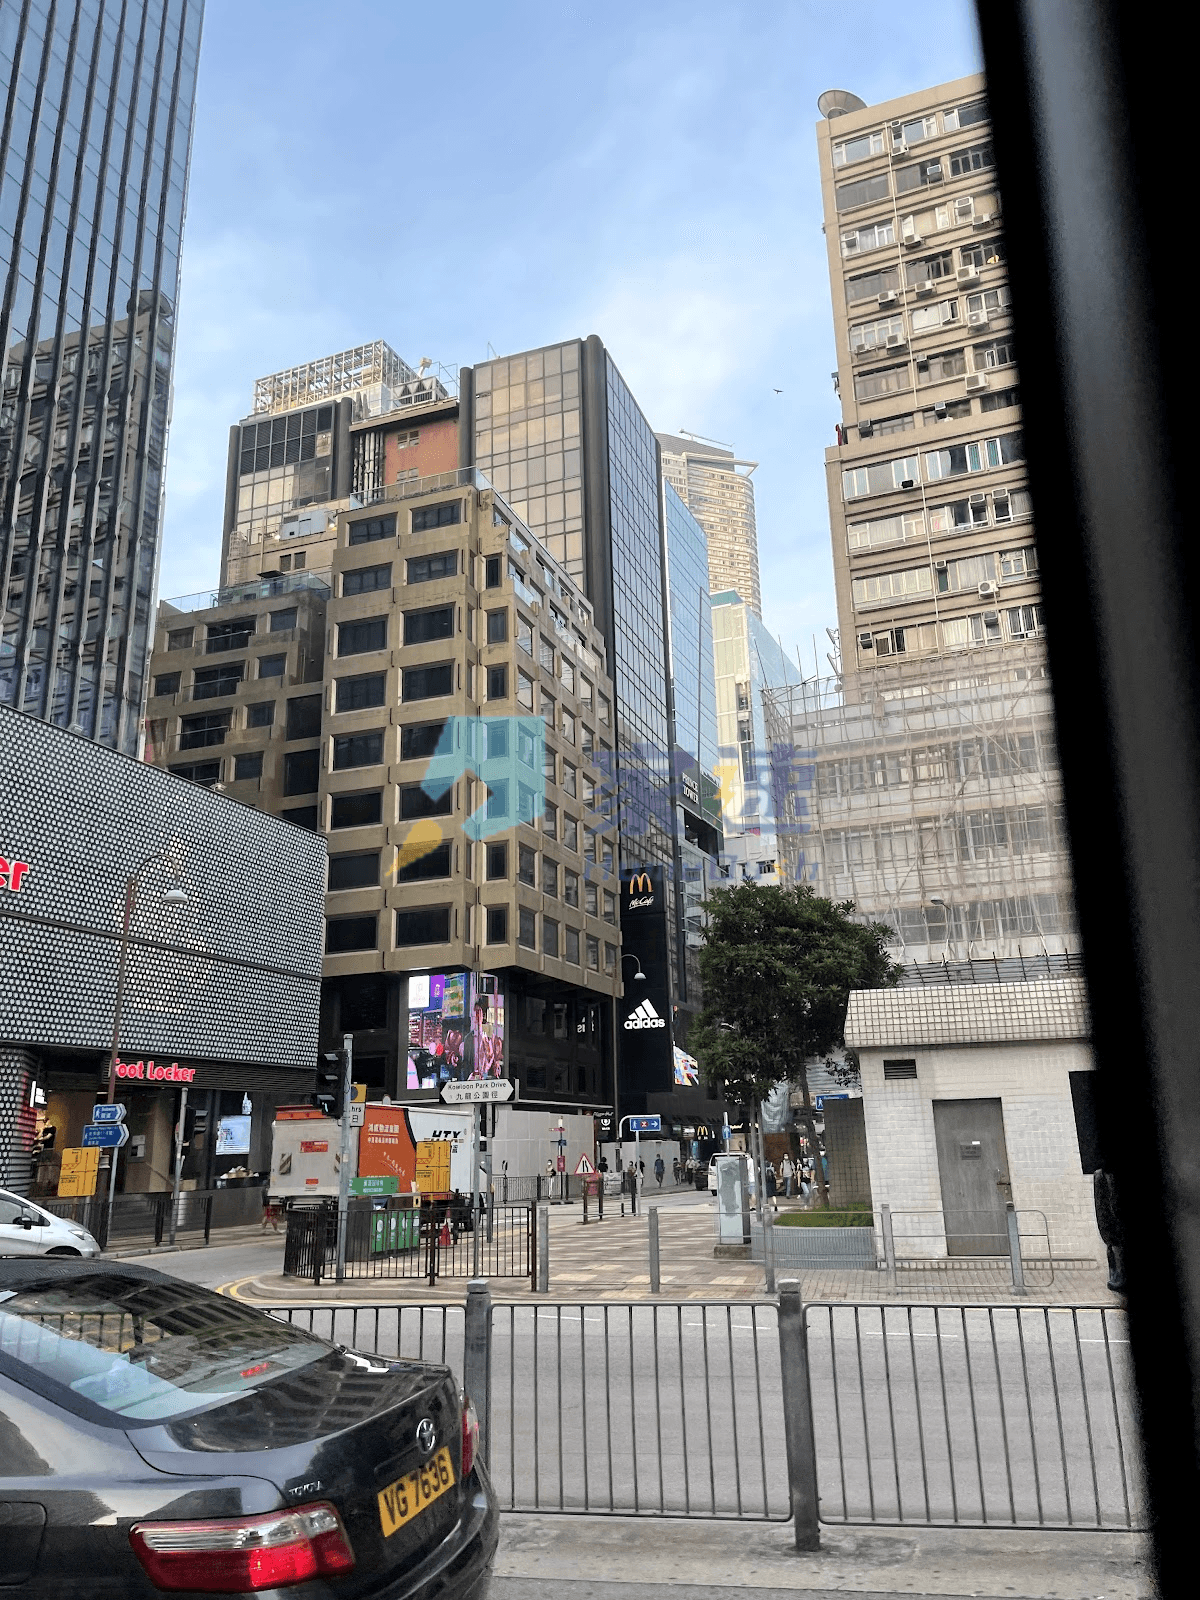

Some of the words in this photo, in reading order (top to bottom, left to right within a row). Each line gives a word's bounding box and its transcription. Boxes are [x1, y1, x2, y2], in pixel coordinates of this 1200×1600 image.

[682, 772, 698, 793] PRINCE
[683, 785, 699, 805] TOWER
[624, 1017, 666, 1030] adidas
[147, 1060, 196, 1083] Locker
[351, 1105, 362, 1113] hrs
[383, 1482, 409, 1525] VG
[409, 1453, 449, 1508] 7636
